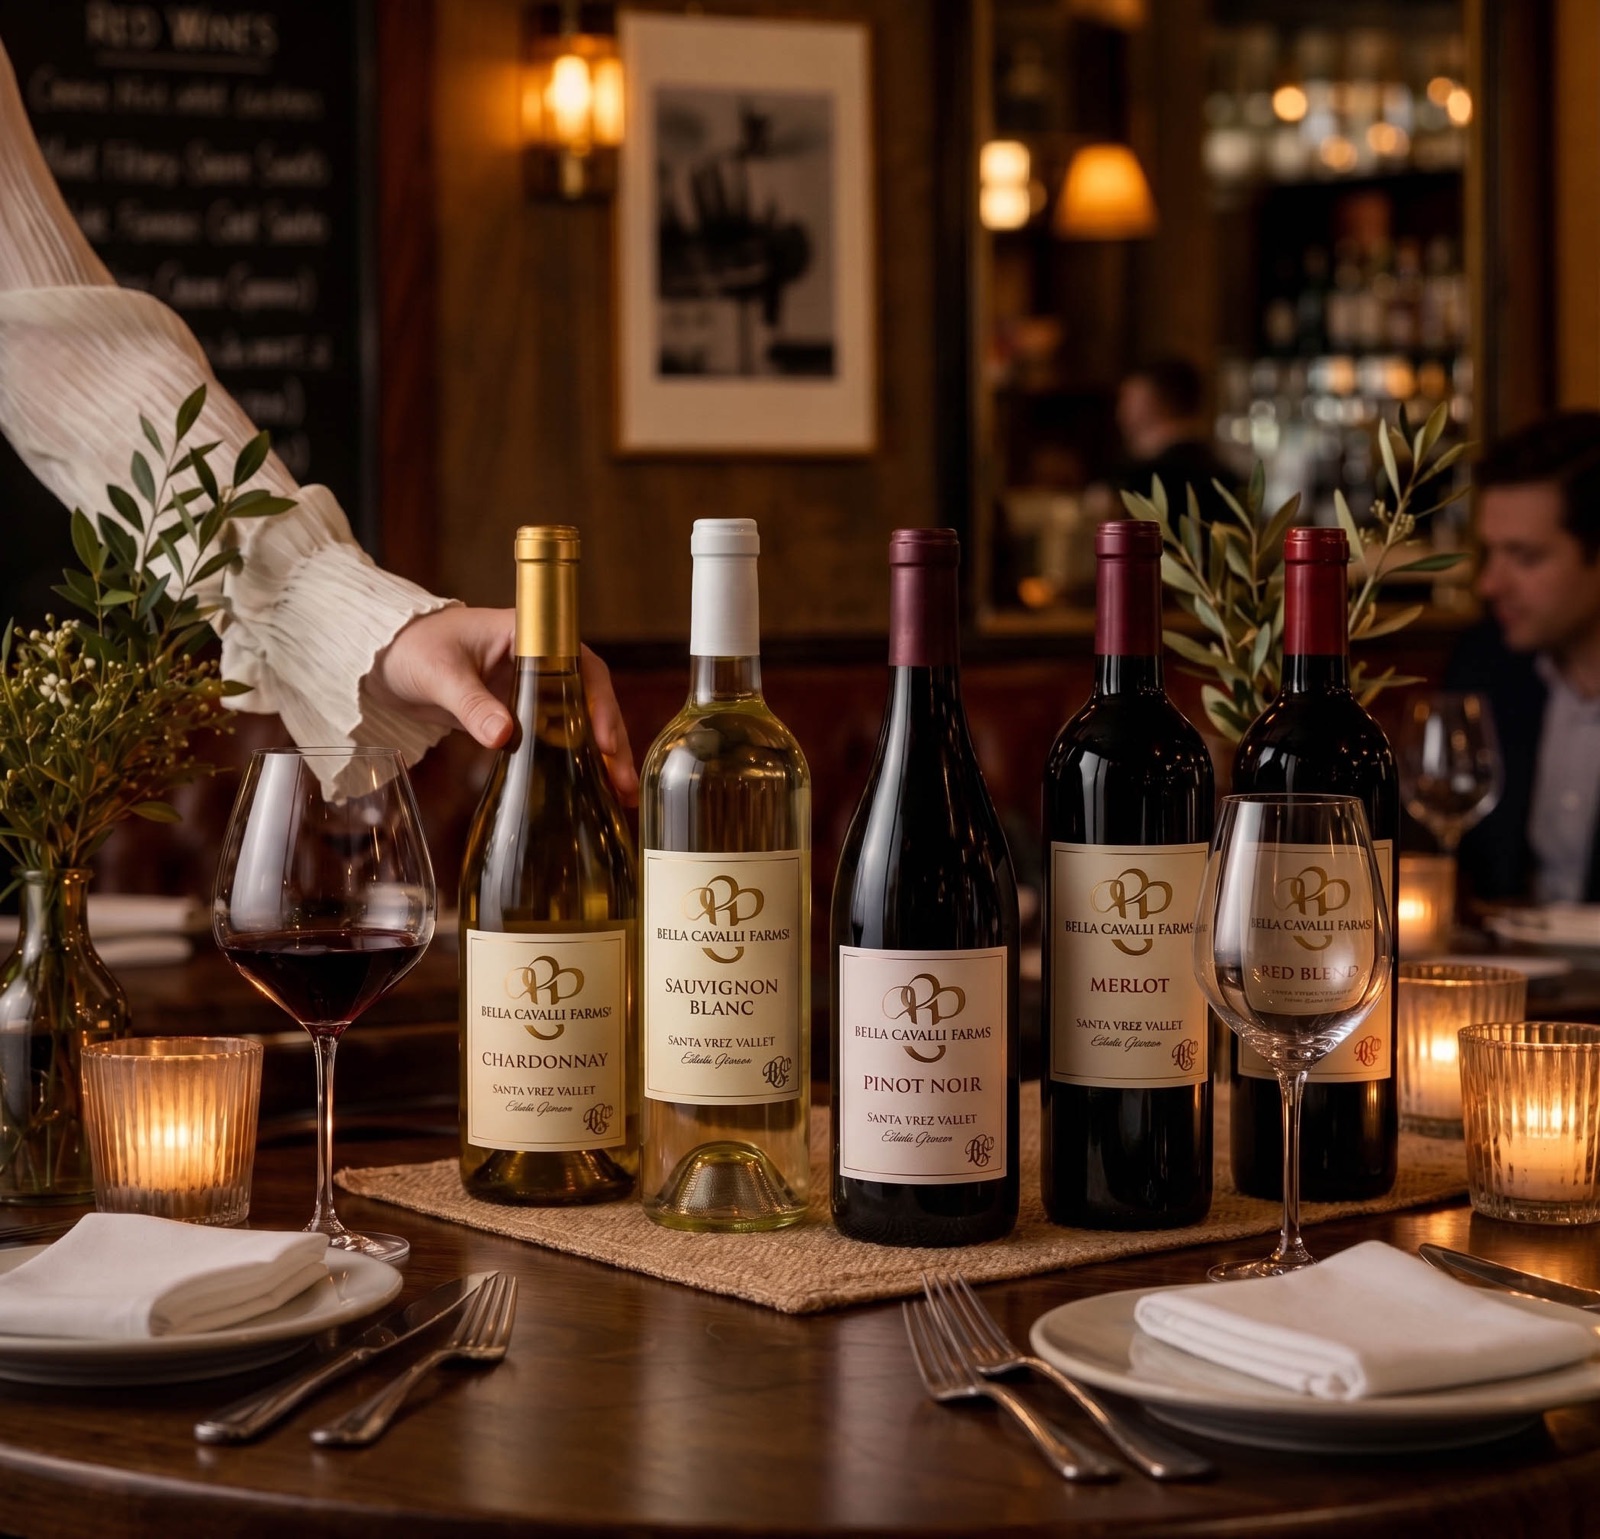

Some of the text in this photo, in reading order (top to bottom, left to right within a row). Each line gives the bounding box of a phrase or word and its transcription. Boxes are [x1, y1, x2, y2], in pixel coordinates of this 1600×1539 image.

[1065, 920, 1098, 934] BELLA
[1101, 922, 1154, 935] CAVALLI
[1251, 918, 1281, 930] BELLA
[1284, 920, 1334, 931] CAVALLI
[657, 928, 688, 941] BELLA
[691, 930, 745, 942] CAVALLI
[1261, 965, 1359, 981] RED BLEND
[665, 978, 778, 995] SAUVIGNON
[1090, 977, 1170, 993] MERLOT
[481, 1005, 512, 1019] BELLA
[514, 1008, 565, 1020] CAVALLI
[690, 1000, 754, 1016] BLANC
[1076, 1018, 1110, 1030] SANTA
[855, 1026, 991, 1041] BELLA CAVALLI FARMS
[668, 1035, 701, 1047] SANTA
[736, 1036, 775, 1048] VALLET
[482, 1051, 609, 1069] CHARDONNAY
[492, 1084, 524, 1096] SANTA
[557, 1085, 596, 1096] VALLET
[863, 1075, 982, 1093] PINOT NOIR
[867, 1112, 902, 1125] SANTA
[938, 1114, 977, 1125] VALLET
